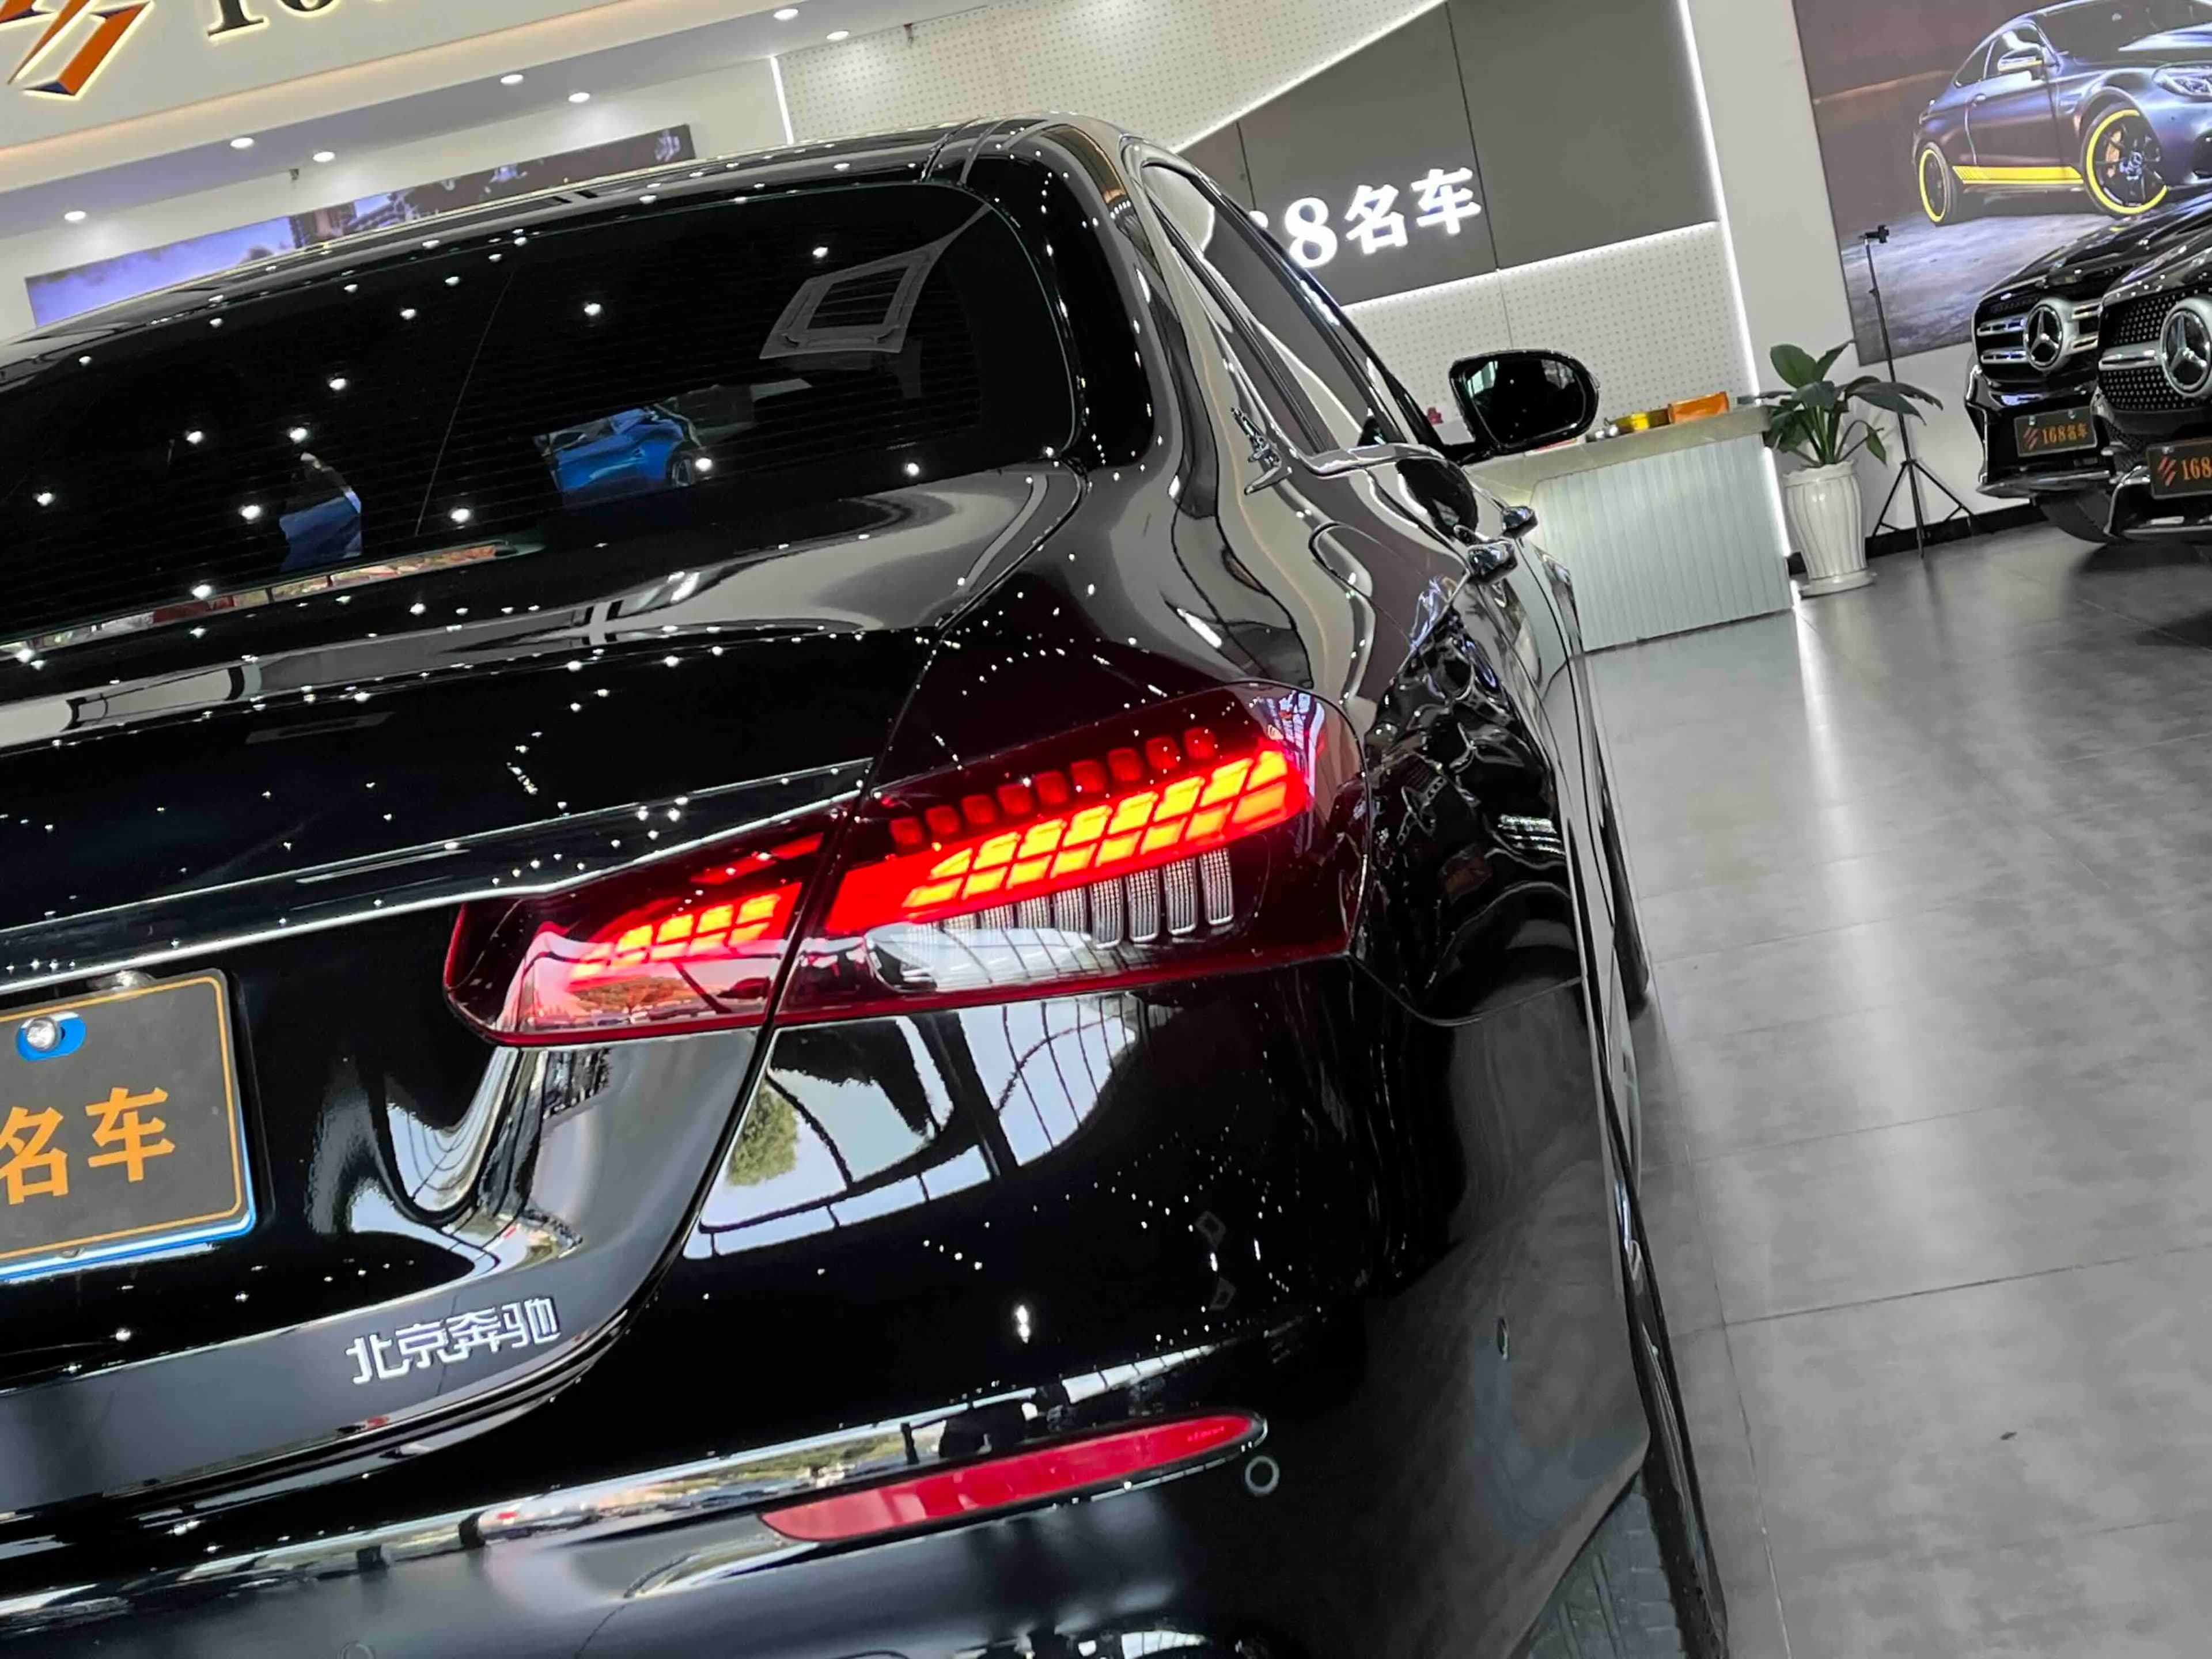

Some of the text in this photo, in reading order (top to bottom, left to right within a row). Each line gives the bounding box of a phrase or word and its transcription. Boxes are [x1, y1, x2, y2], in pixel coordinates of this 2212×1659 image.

[1249, 168, 1482, 268] 8名车
[2181, 457, 2212, 480] 168
[0, 1087, 176, 1205] 名车
[346, 1297, 561, 1384] 北京奔驰
